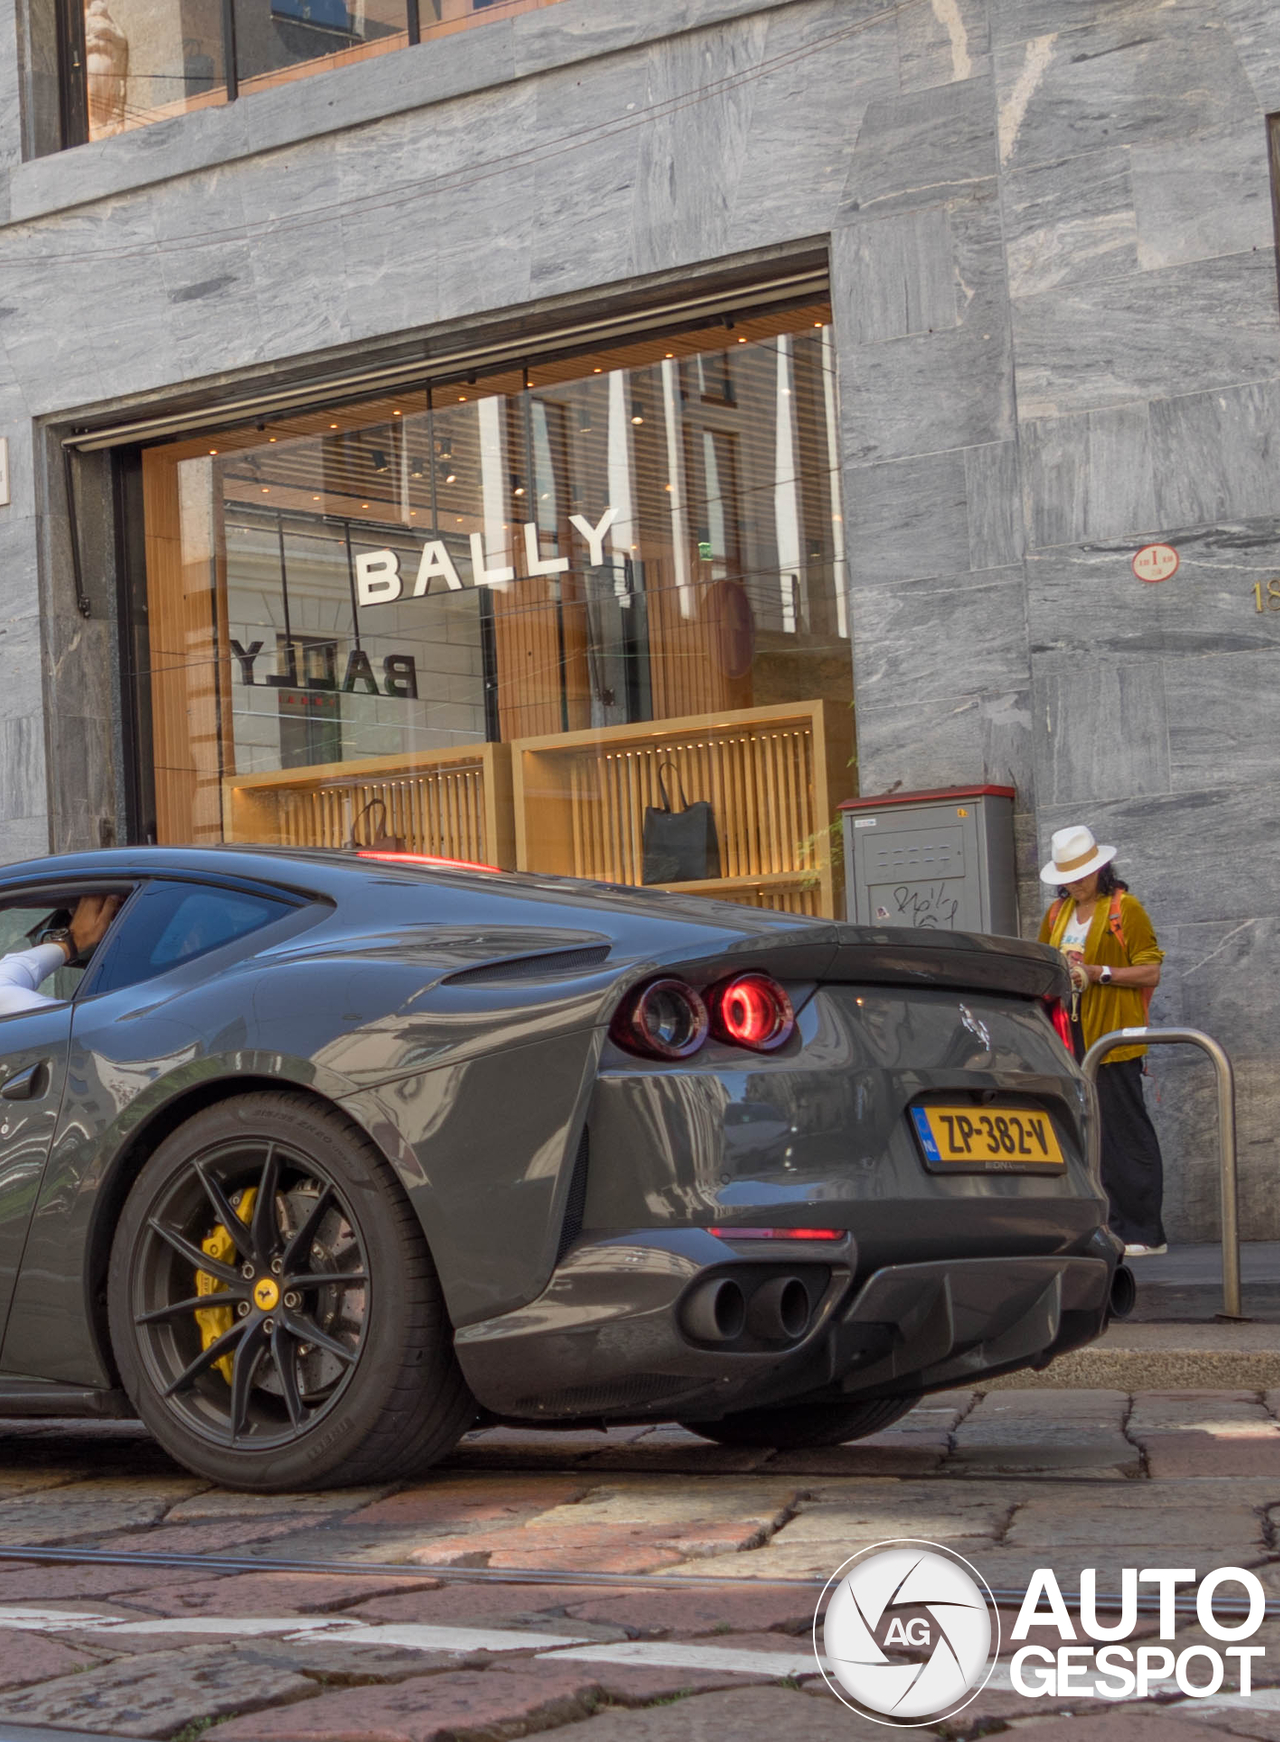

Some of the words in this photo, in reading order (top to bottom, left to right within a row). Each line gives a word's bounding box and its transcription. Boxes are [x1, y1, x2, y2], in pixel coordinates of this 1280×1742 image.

[356, 508, 619, 607] BALLY
[923, 1140, 936, 1152] NL
[939, 1115, 1049, 1156] ZP-382-V
